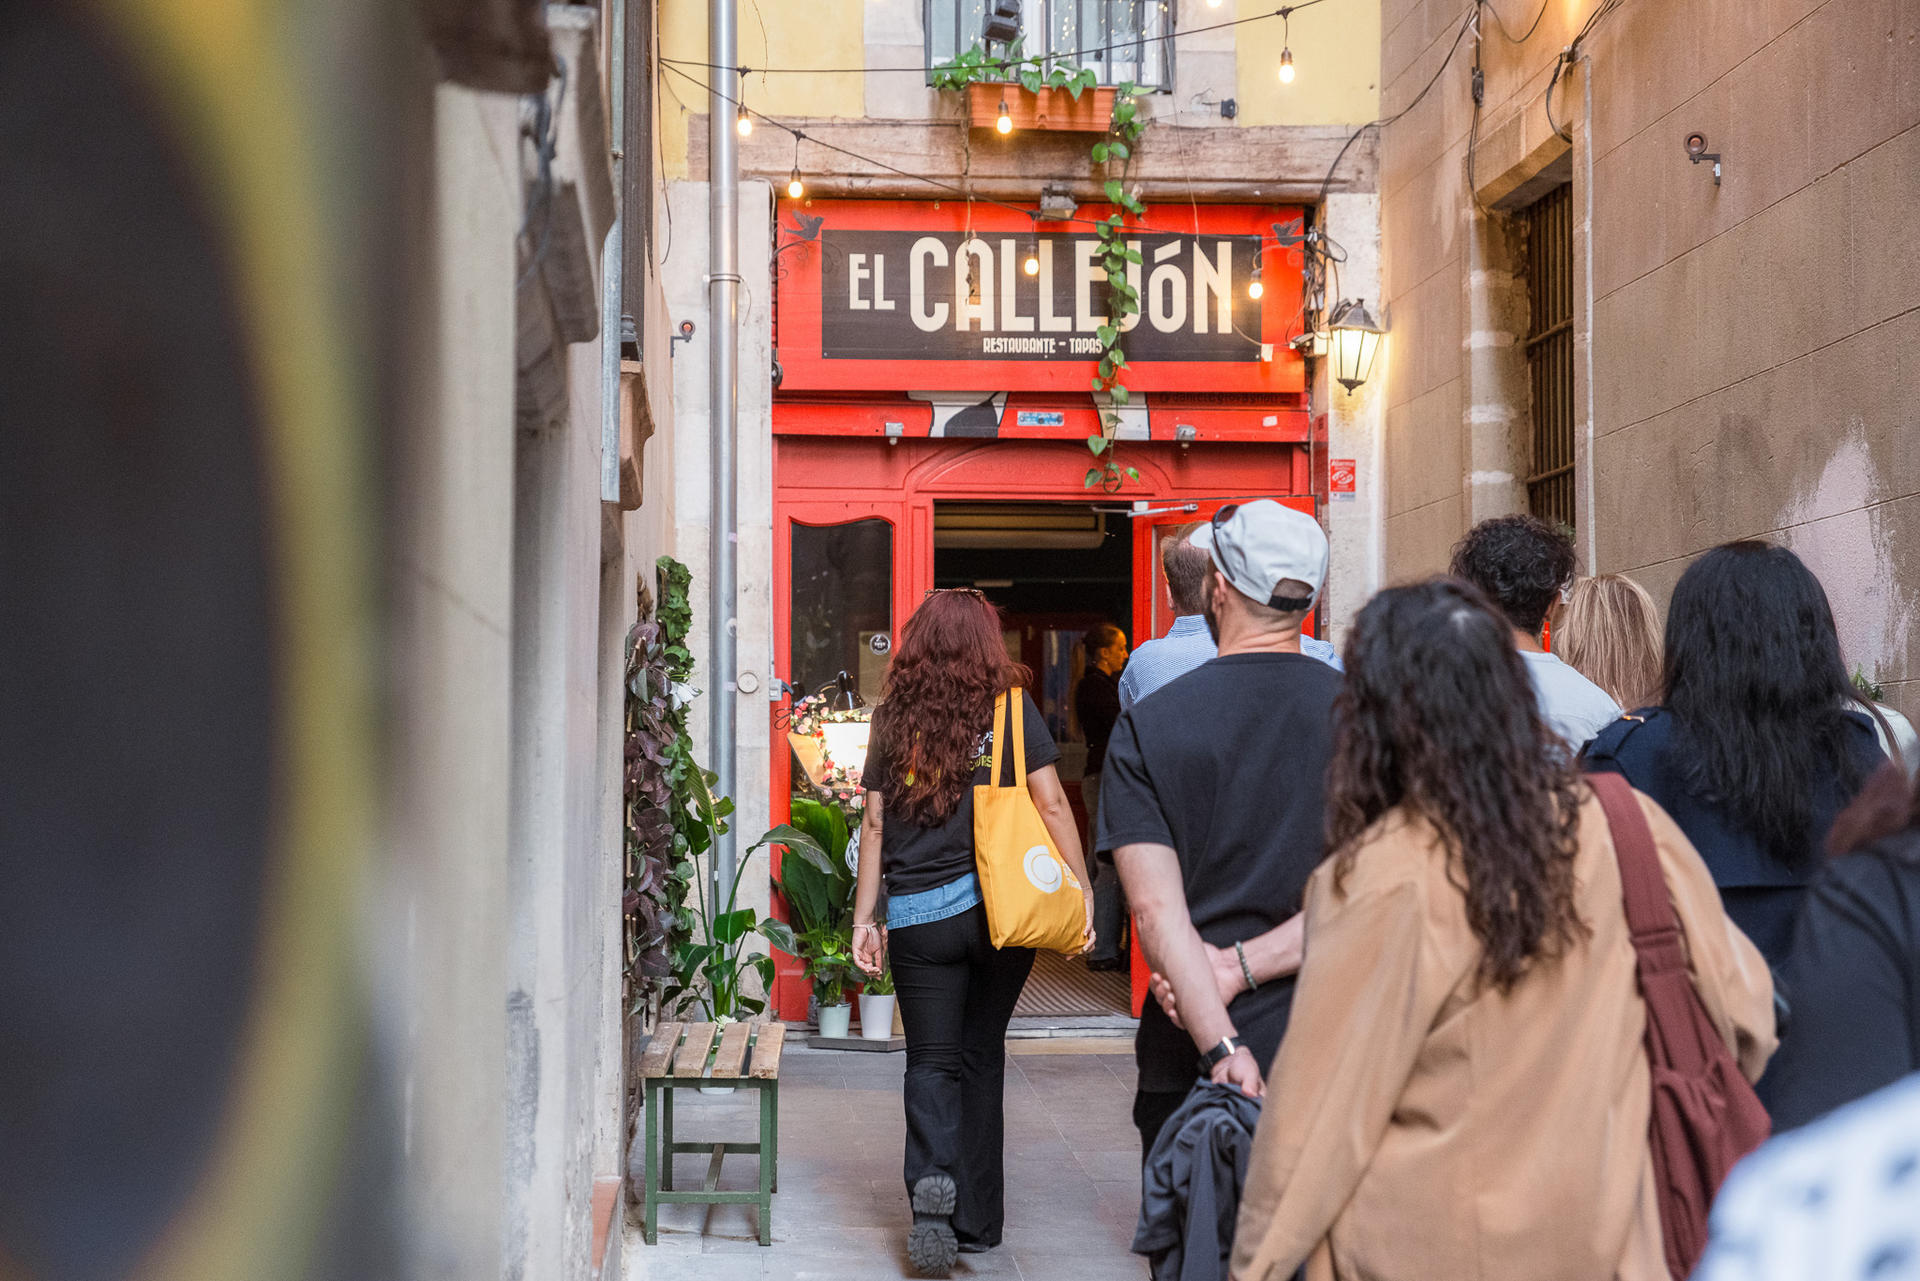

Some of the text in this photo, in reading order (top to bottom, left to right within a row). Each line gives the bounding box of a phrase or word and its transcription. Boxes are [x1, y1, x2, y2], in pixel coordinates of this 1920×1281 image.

[849, 236, 1233, 334] EL CALLEJÓN
[982, 337, 1056, 354] RESTAURANTE
[1068, 337, 1104, 354] TAPAS
